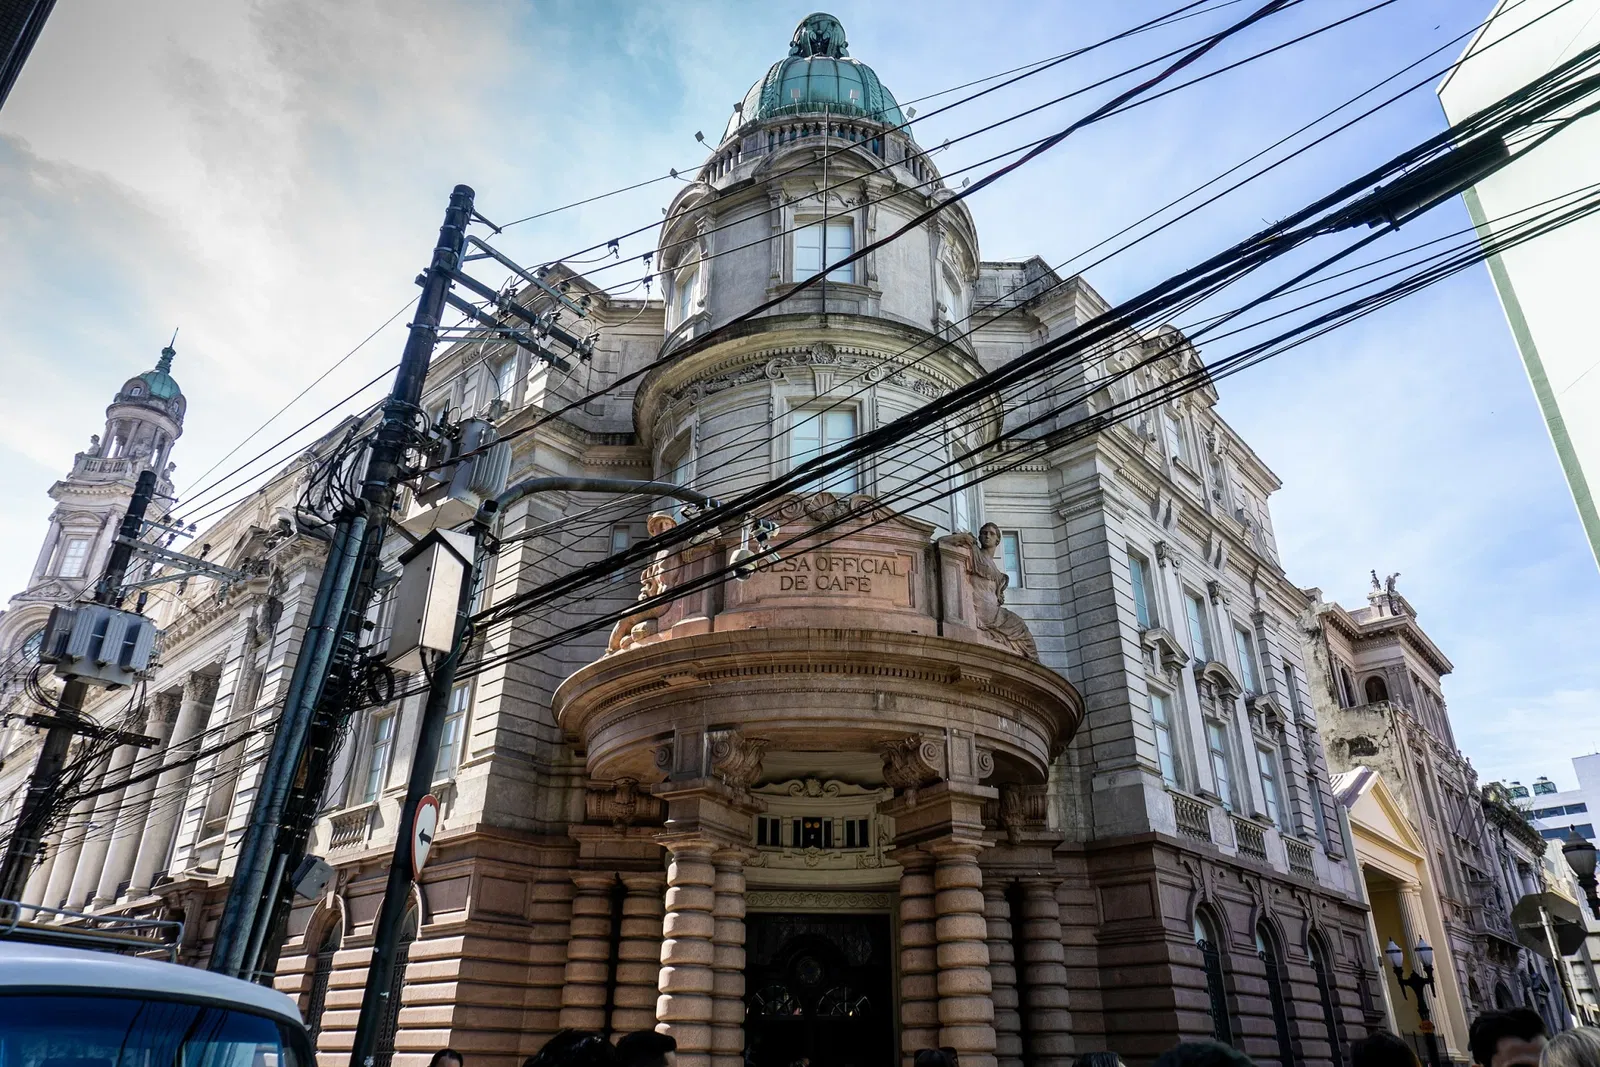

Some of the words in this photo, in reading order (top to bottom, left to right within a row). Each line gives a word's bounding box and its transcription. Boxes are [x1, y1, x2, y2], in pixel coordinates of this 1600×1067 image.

[747, 557, 811, 573] OLSA
[815, 556, 906, 577] OFFICIAL
[780, 576, 808, 591] DE
